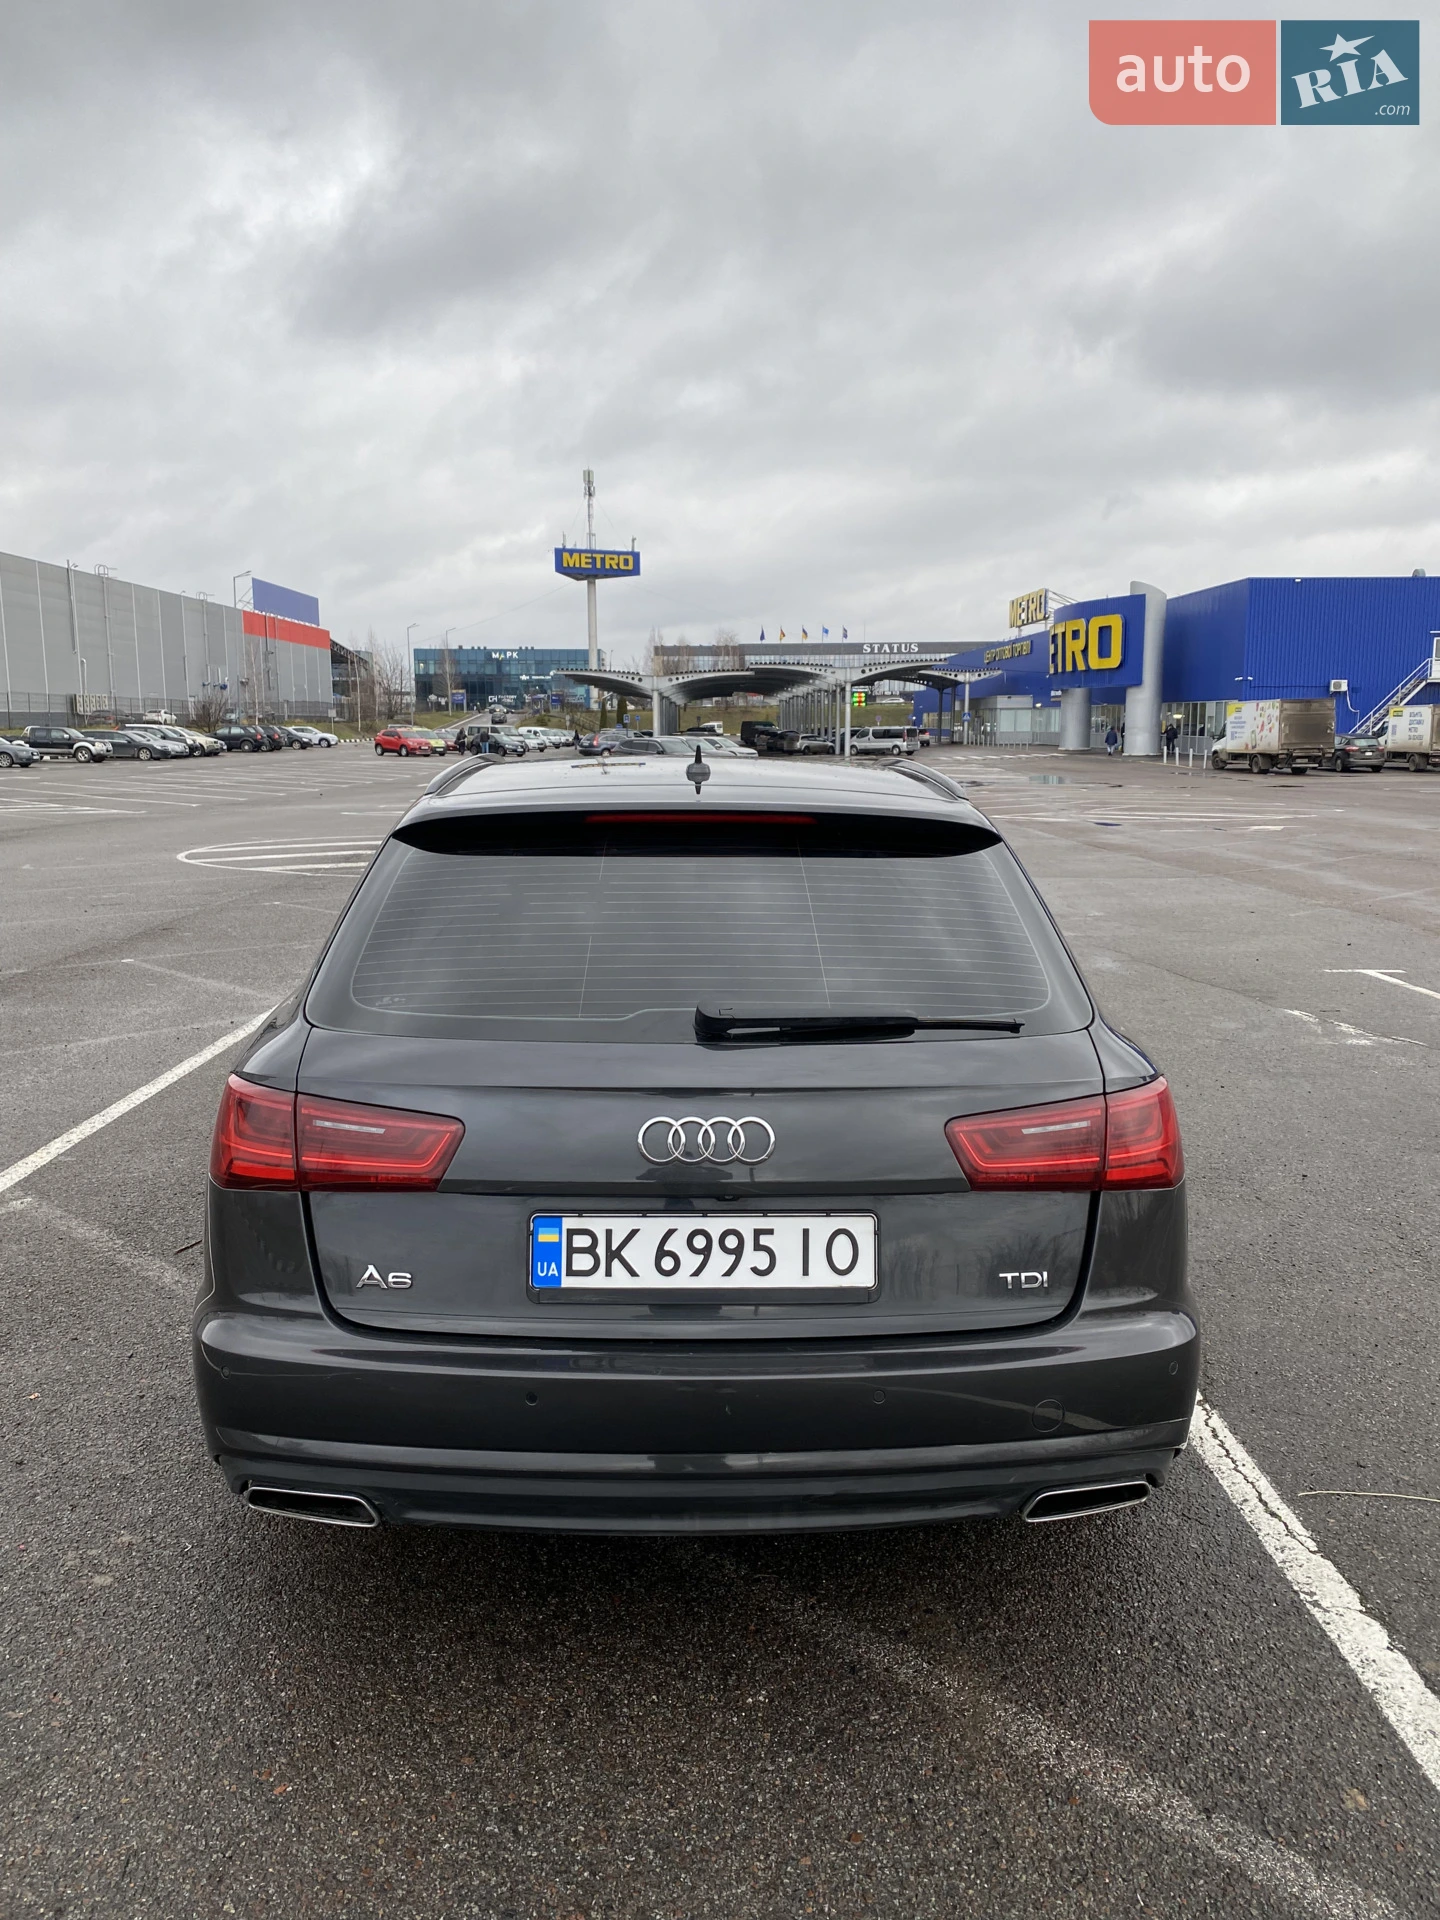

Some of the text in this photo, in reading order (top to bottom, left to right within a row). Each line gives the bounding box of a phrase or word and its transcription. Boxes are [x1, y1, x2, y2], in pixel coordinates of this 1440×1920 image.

[562, 552, 634, 571] METRO
[1009, 588, 1047, 629] METRO
[862, 643, 919, 654] STATUS
[565, 1227, 641, 1278] BK
[654, 1227, 777, 1278] 6995
[355, 1263, 413, 1290] A6
[537, 1261, 559, 1277] UA
[998, 1270, 1049, 1290] TDI
